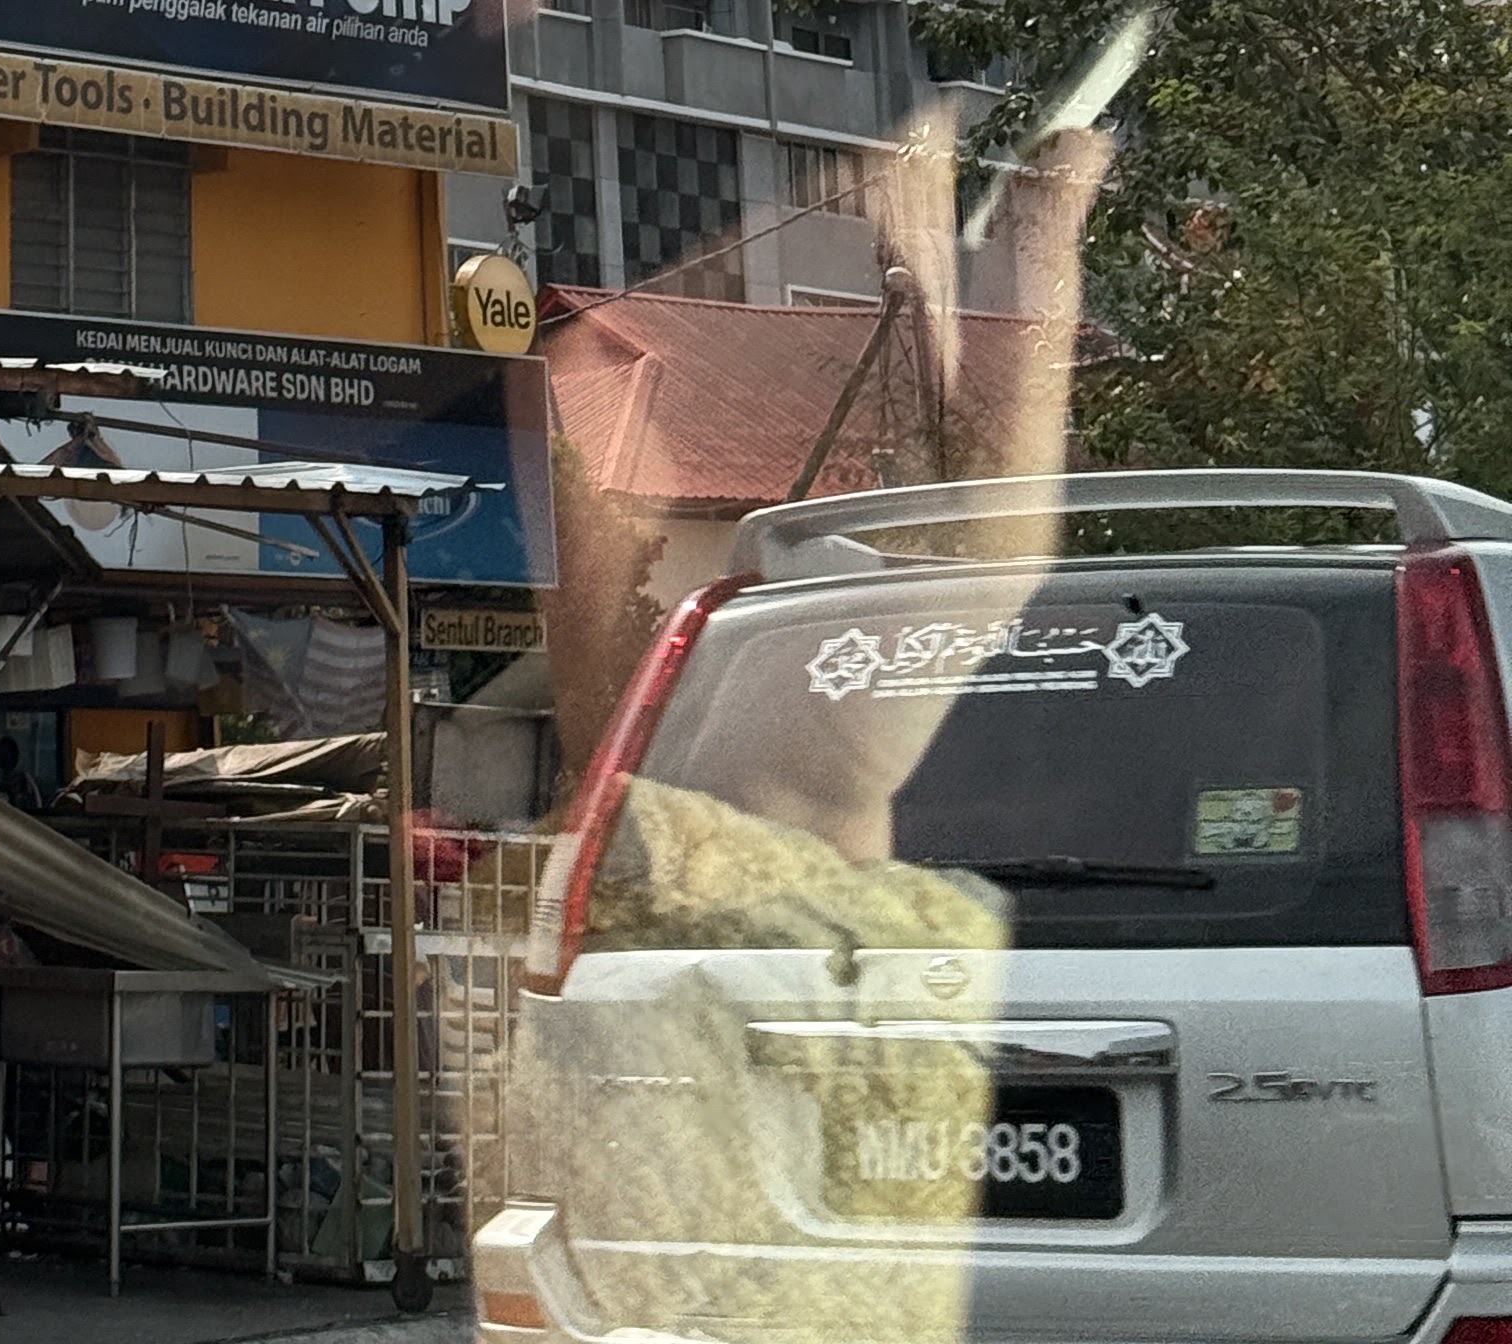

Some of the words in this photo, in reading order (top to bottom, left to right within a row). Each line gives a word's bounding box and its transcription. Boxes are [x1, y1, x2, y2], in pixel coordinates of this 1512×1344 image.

[305, 11, 330, 37] air
[331, 14, 385, 47] pilihan
[387, 20, 428, 48] anda
[33, 59, 135, 115] Tools
[163, 79, 330, 152] Building
[342, 110, 499, 162] Material
[473, 286, 531, 330] Yale
[76, 329, 123, 350] KEDAI
[125, 334, 203, 357] MENJUAL
[204, 339, 253, 360] KUNCI
[255, 344, 288, 364] DAN
[290, 347, 367, 372] ALAT-ALAT
[369, 353, 422, 375] LOGAM
[281, 371, 325, 401] SDN
[329, 375, 375, 407] BHD
[424, 613, 479, 646] Sentul
[483, 614, 543, 647] Branch
